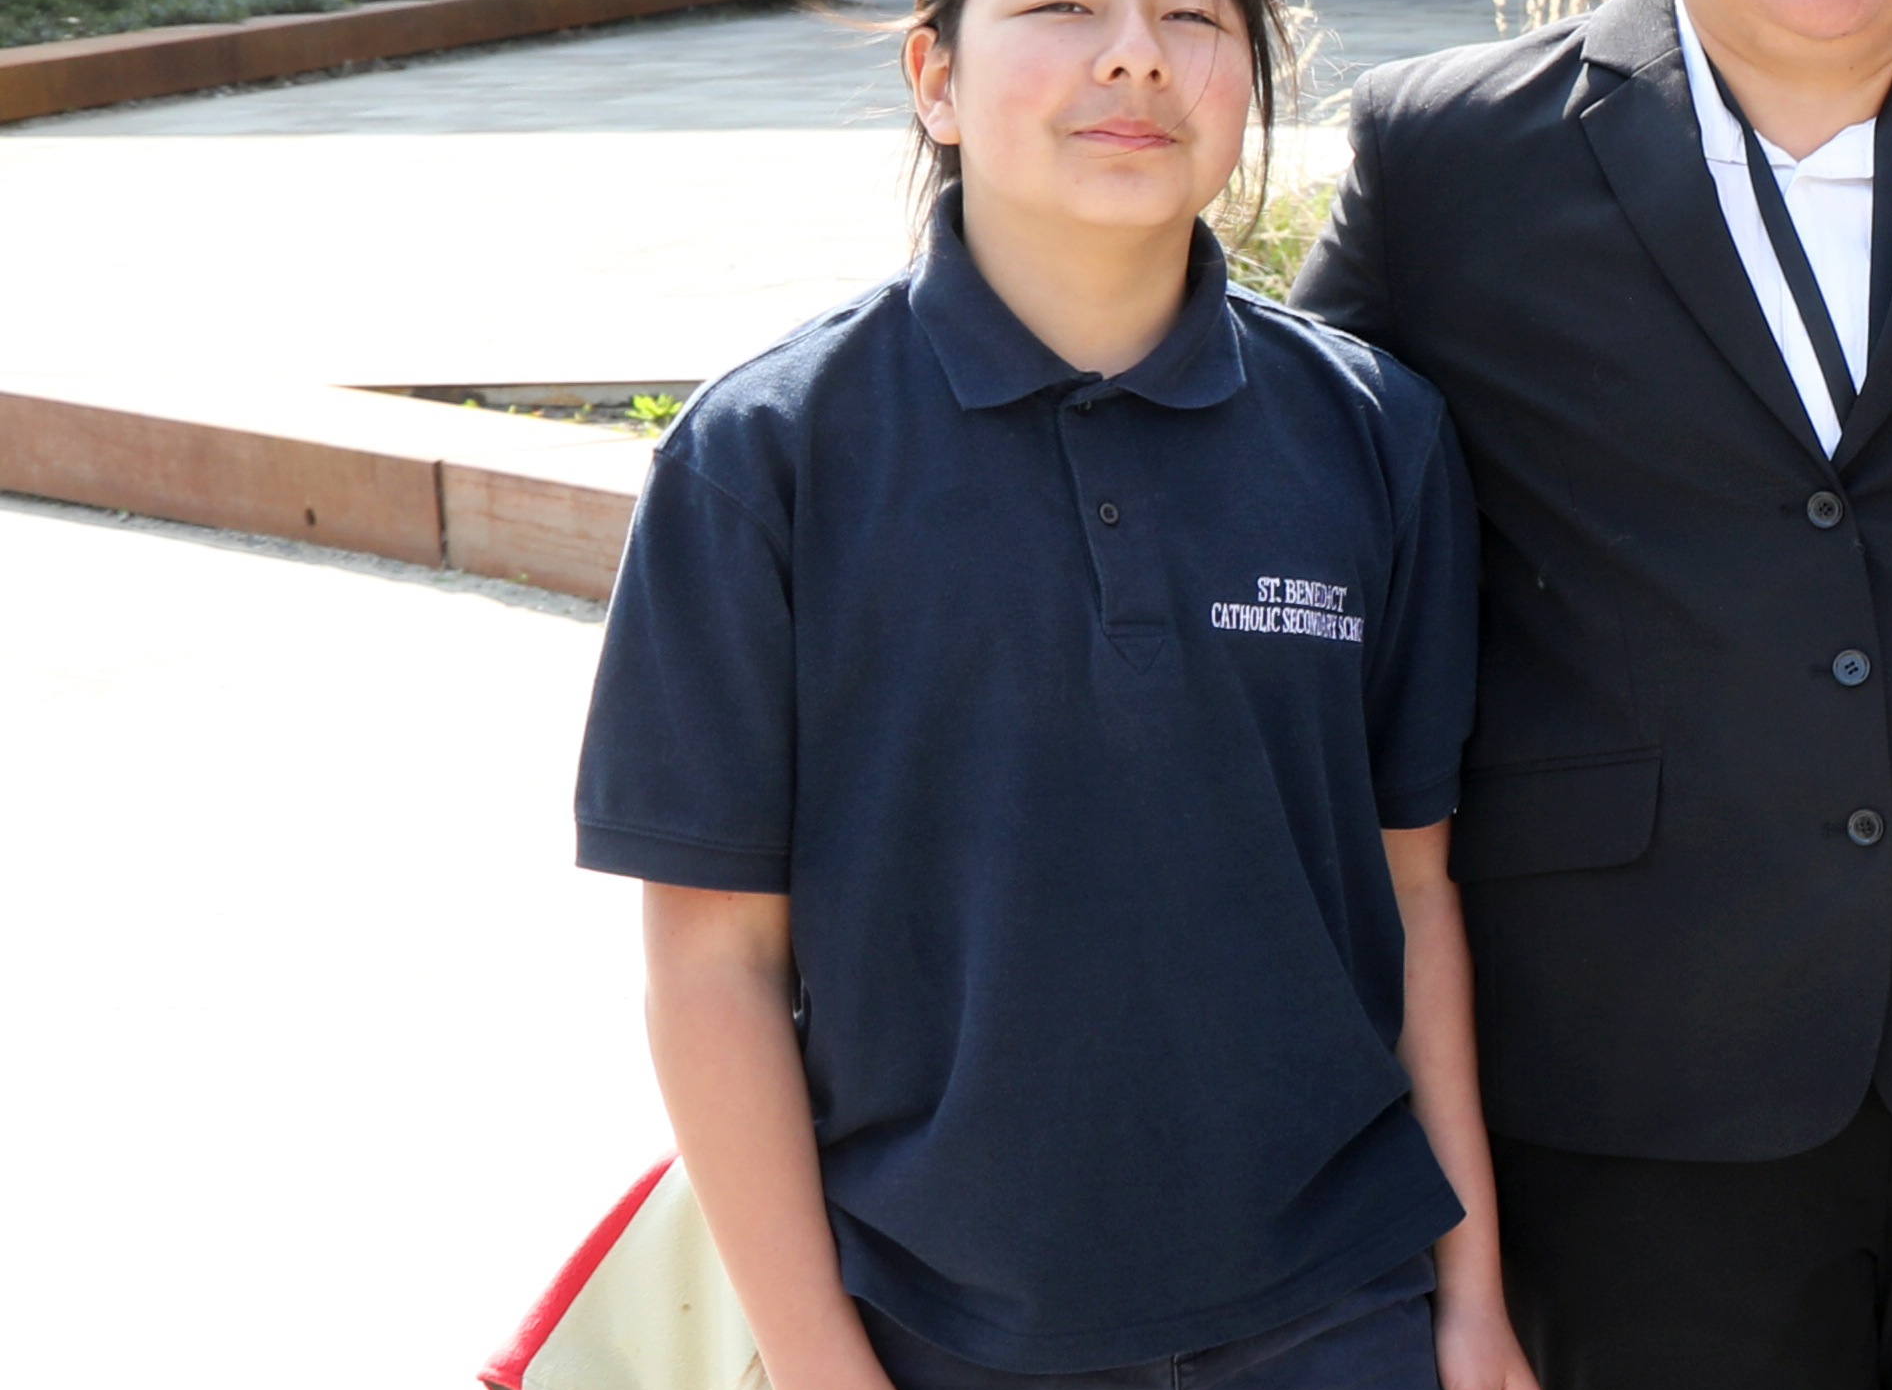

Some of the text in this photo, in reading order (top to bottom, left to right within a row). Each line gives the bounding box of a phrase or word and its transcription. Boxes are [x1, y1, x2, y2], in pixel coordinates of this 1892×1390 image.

[1257, 576, 1347, 612] ST. BENEDICT
[1211, 602, 1281, 633] CATHOLIC
